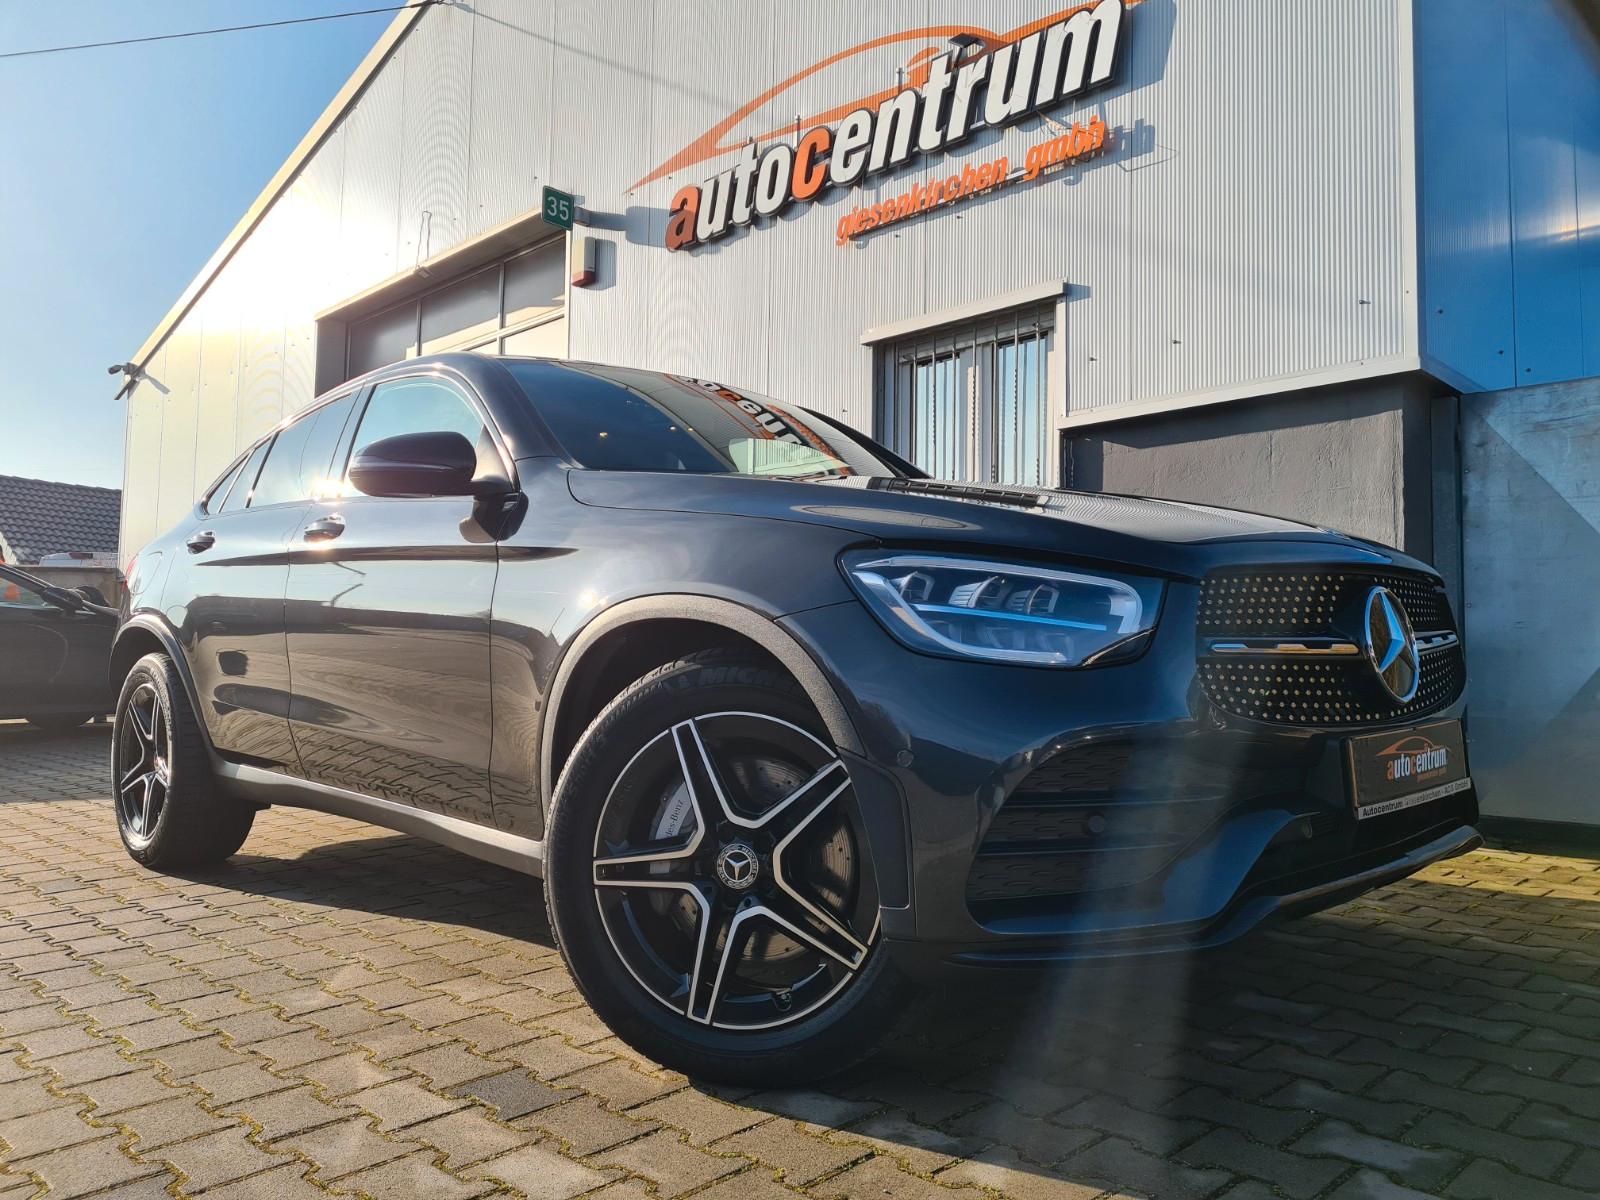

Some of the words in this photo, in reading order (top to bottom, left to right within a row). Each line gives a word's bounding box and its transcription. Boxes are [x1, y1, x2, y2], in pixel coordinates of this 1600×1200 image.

[665, 0, 1124, 253] autocentrum
[547, 196, 569, 221] 35
[835, 157, 1008, 247] giesenkirchen
[1023, 115, 1105, 181] gmbh
[1386, 748, 1447, 782] autocentrum
